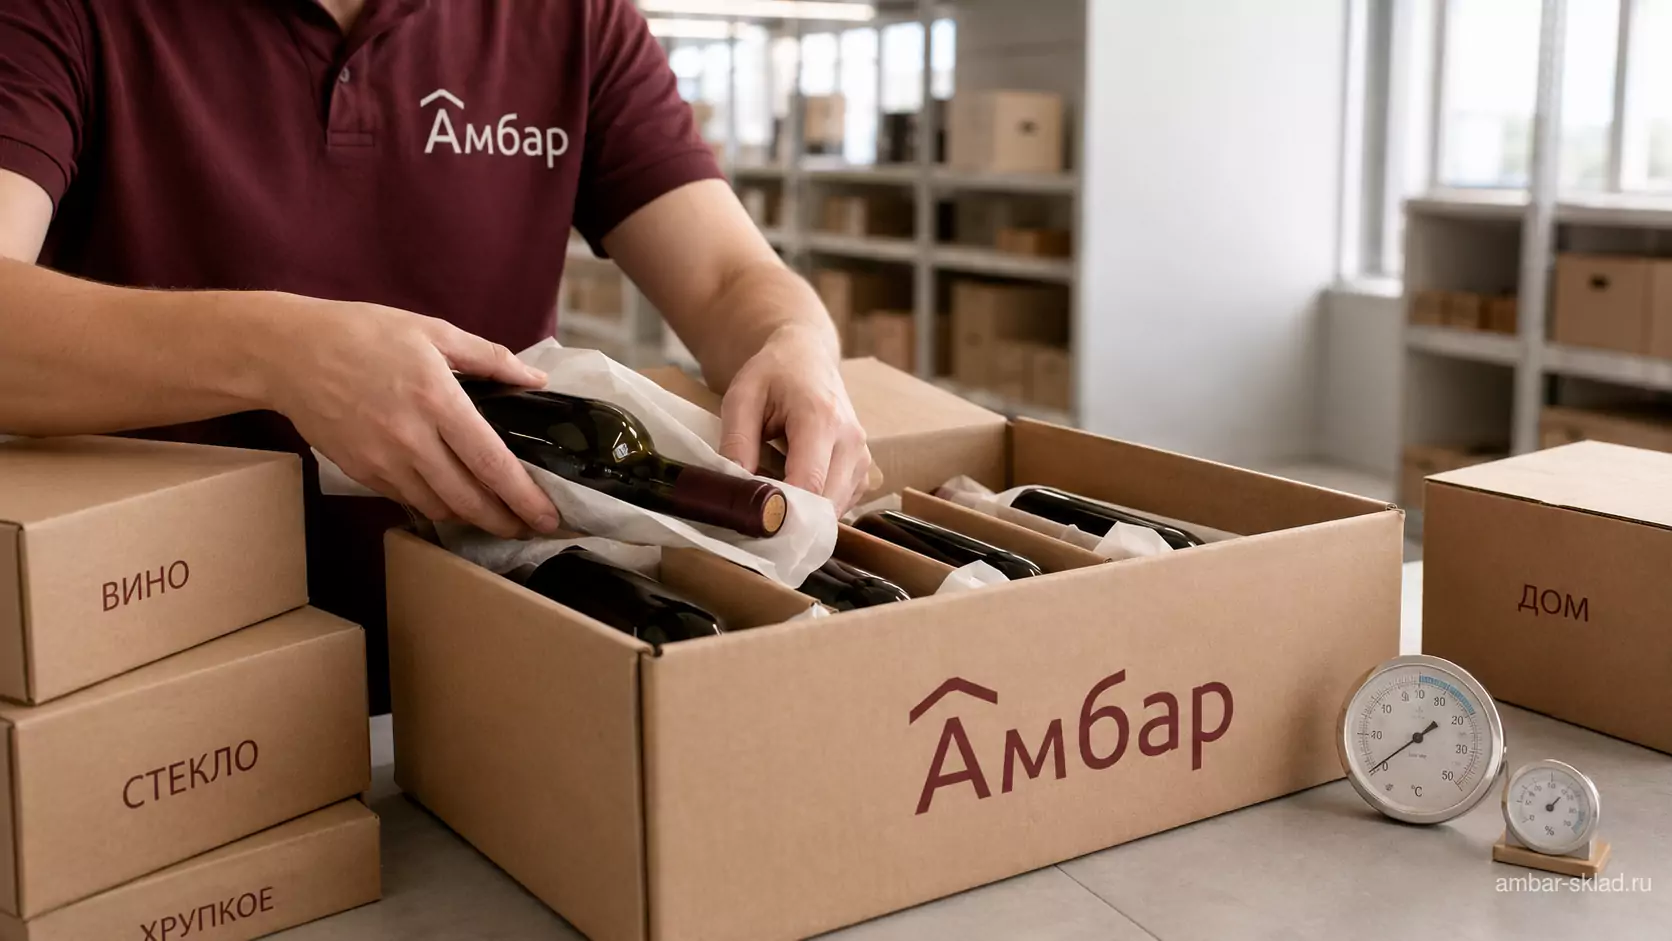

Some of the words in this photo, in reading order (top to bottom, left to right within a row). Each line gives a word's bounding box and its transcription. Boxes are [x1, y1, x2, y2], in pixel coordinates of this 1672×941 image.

[424, 107, 569, 169] Амбар
[102, 560, 190, 612] ВИНО
[1518, 584, 1588, 622] ДОМ
[914, 668, 1234, 816] Амбар
[122, 739, 259, 809] СТЕКЛО
[1442, 770, 1454, 781] 50
[140, 886, 274, 941] ХРУПКОЕ
